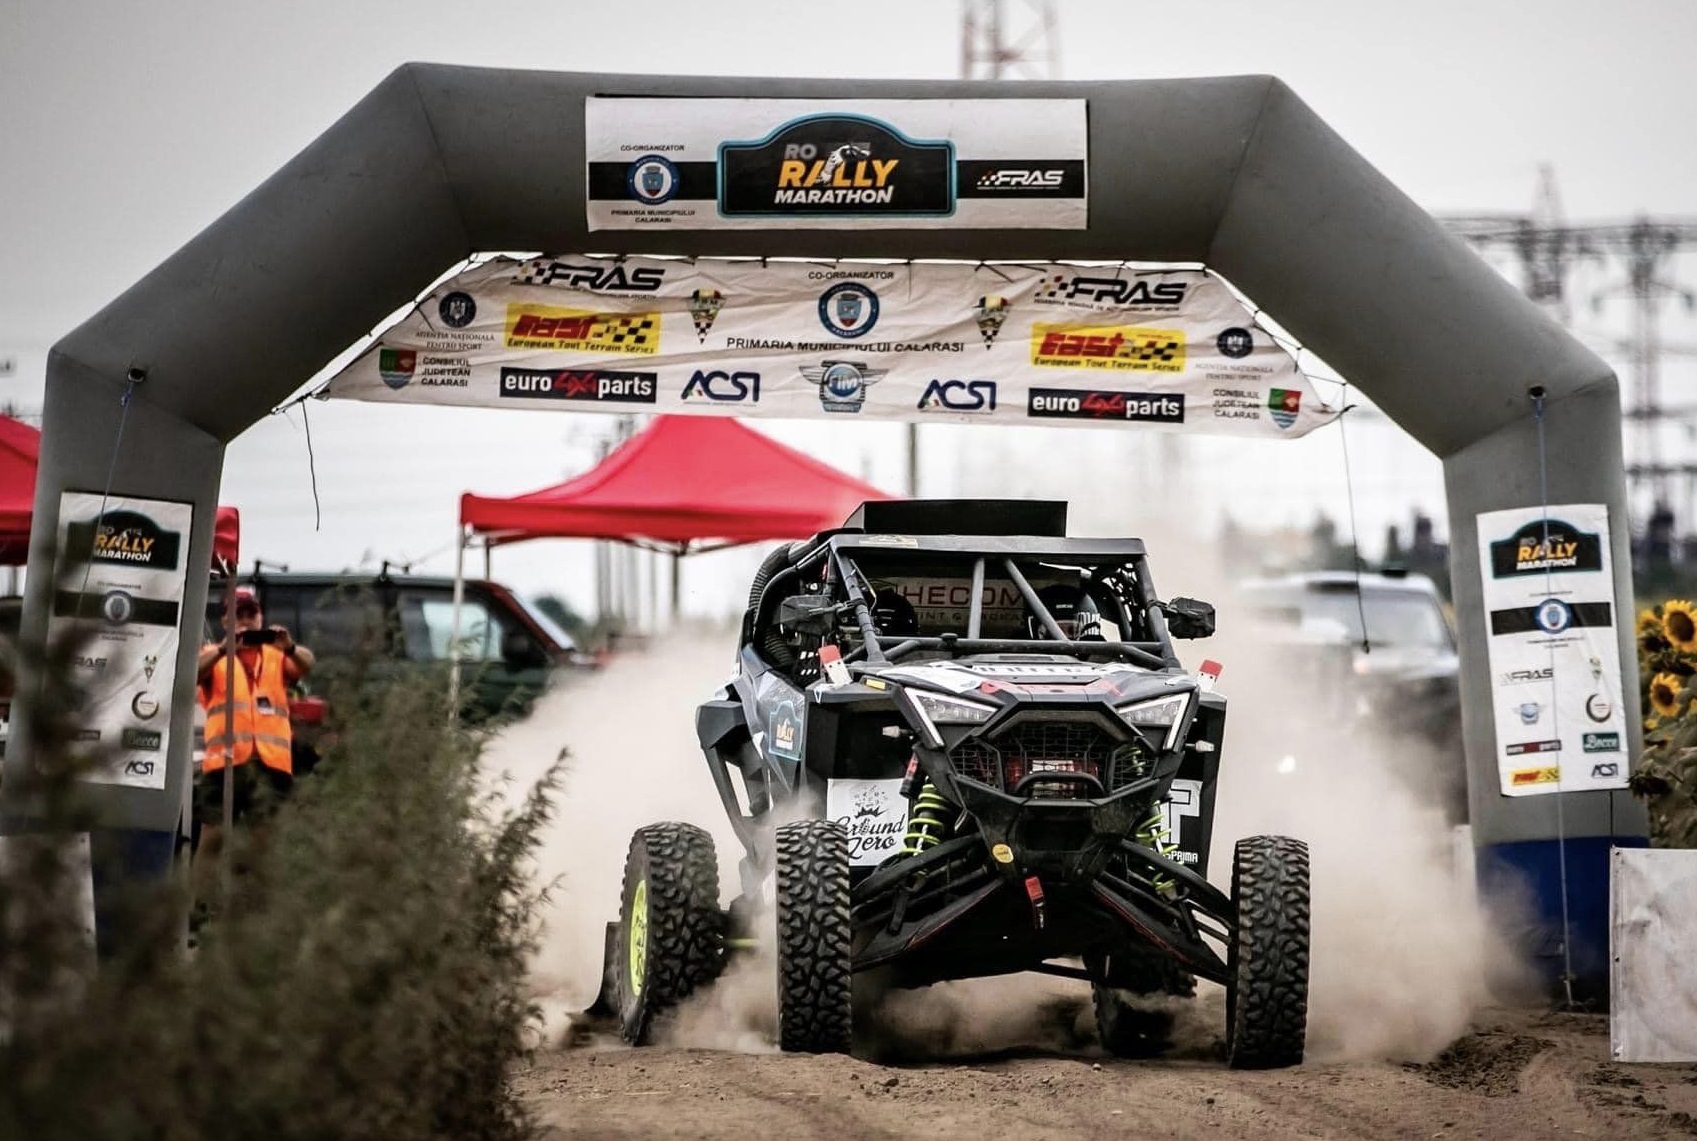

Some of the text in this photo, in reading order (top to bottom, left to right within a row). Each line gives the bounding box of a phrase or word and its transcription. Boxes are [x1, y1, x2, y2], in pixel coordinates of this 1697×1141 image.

[784, 143, 817, 160] RO
[778, 159, 899, 187] RALLY
[995, 170, 1064, 185] FRAS
[774, 185, 894, 203] MARATHON
[543, 262, 666, 291] FRAS
[808, 271, 894, 279] CO-ORGANIZATOR
[1065, 277, 1188, 304] FRAS
[507, 338, 554, 348] European
[585, 341, 621, 352] Terrain
[625, 344, 655, 354] Series
[727, 337, 793, 350] PRIMARIA
[894, 341, 964, 352] CALARASI
[1033, 357, 1081, 366] European
[1112, 359, 1148, 369] Terrain
[1152, 361, 1181, 371] Series
[421, 377, 468, 387] CALARASI
[95, 534, 155, 552] RALLY
[1517, 542, 1578, 561] RALLY
[1516, 556, 1577, 570] MARATHON
